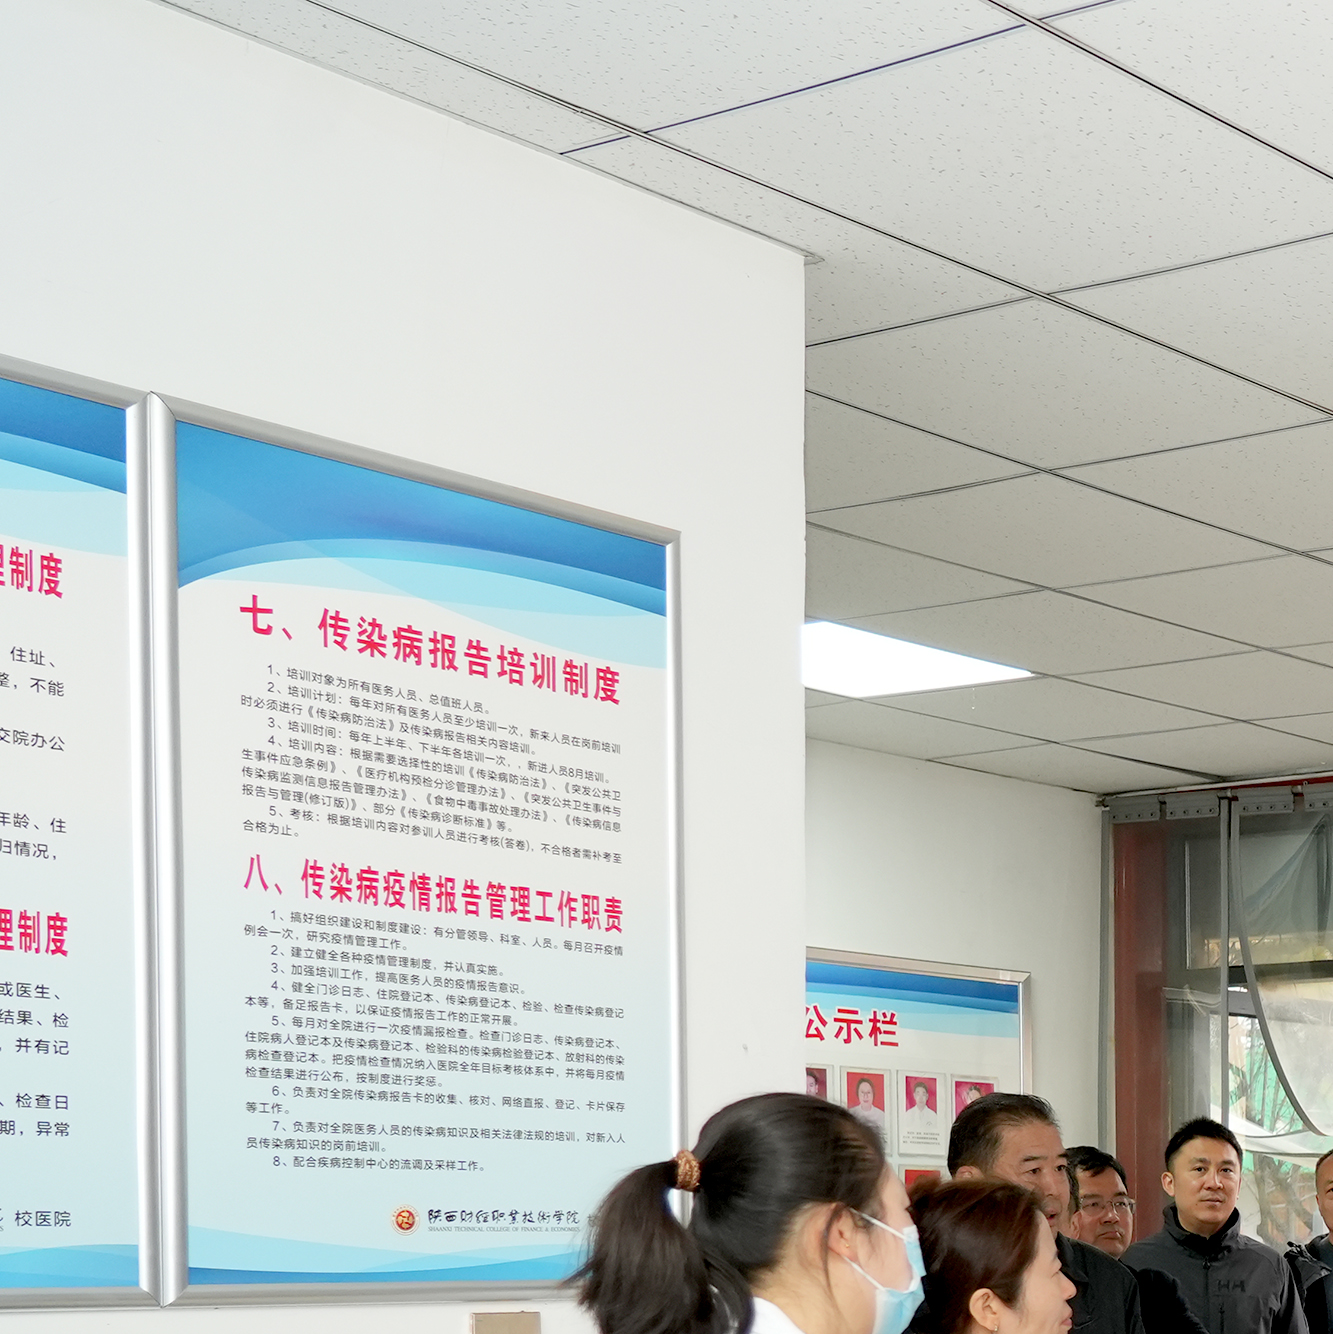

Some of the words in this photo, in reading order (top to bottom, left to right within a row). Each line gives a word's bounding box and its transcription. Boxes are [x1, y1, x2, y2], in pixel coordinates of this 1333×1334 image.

[239, 594, 621, 705] 七、传染病报告培训制度
[243, 853, 623, 934] 八、传染病疫情报告管理工作职责
[805, 1005, 899, 1047] 公示栏
[14, 1209, 71, 1228] 校医院
